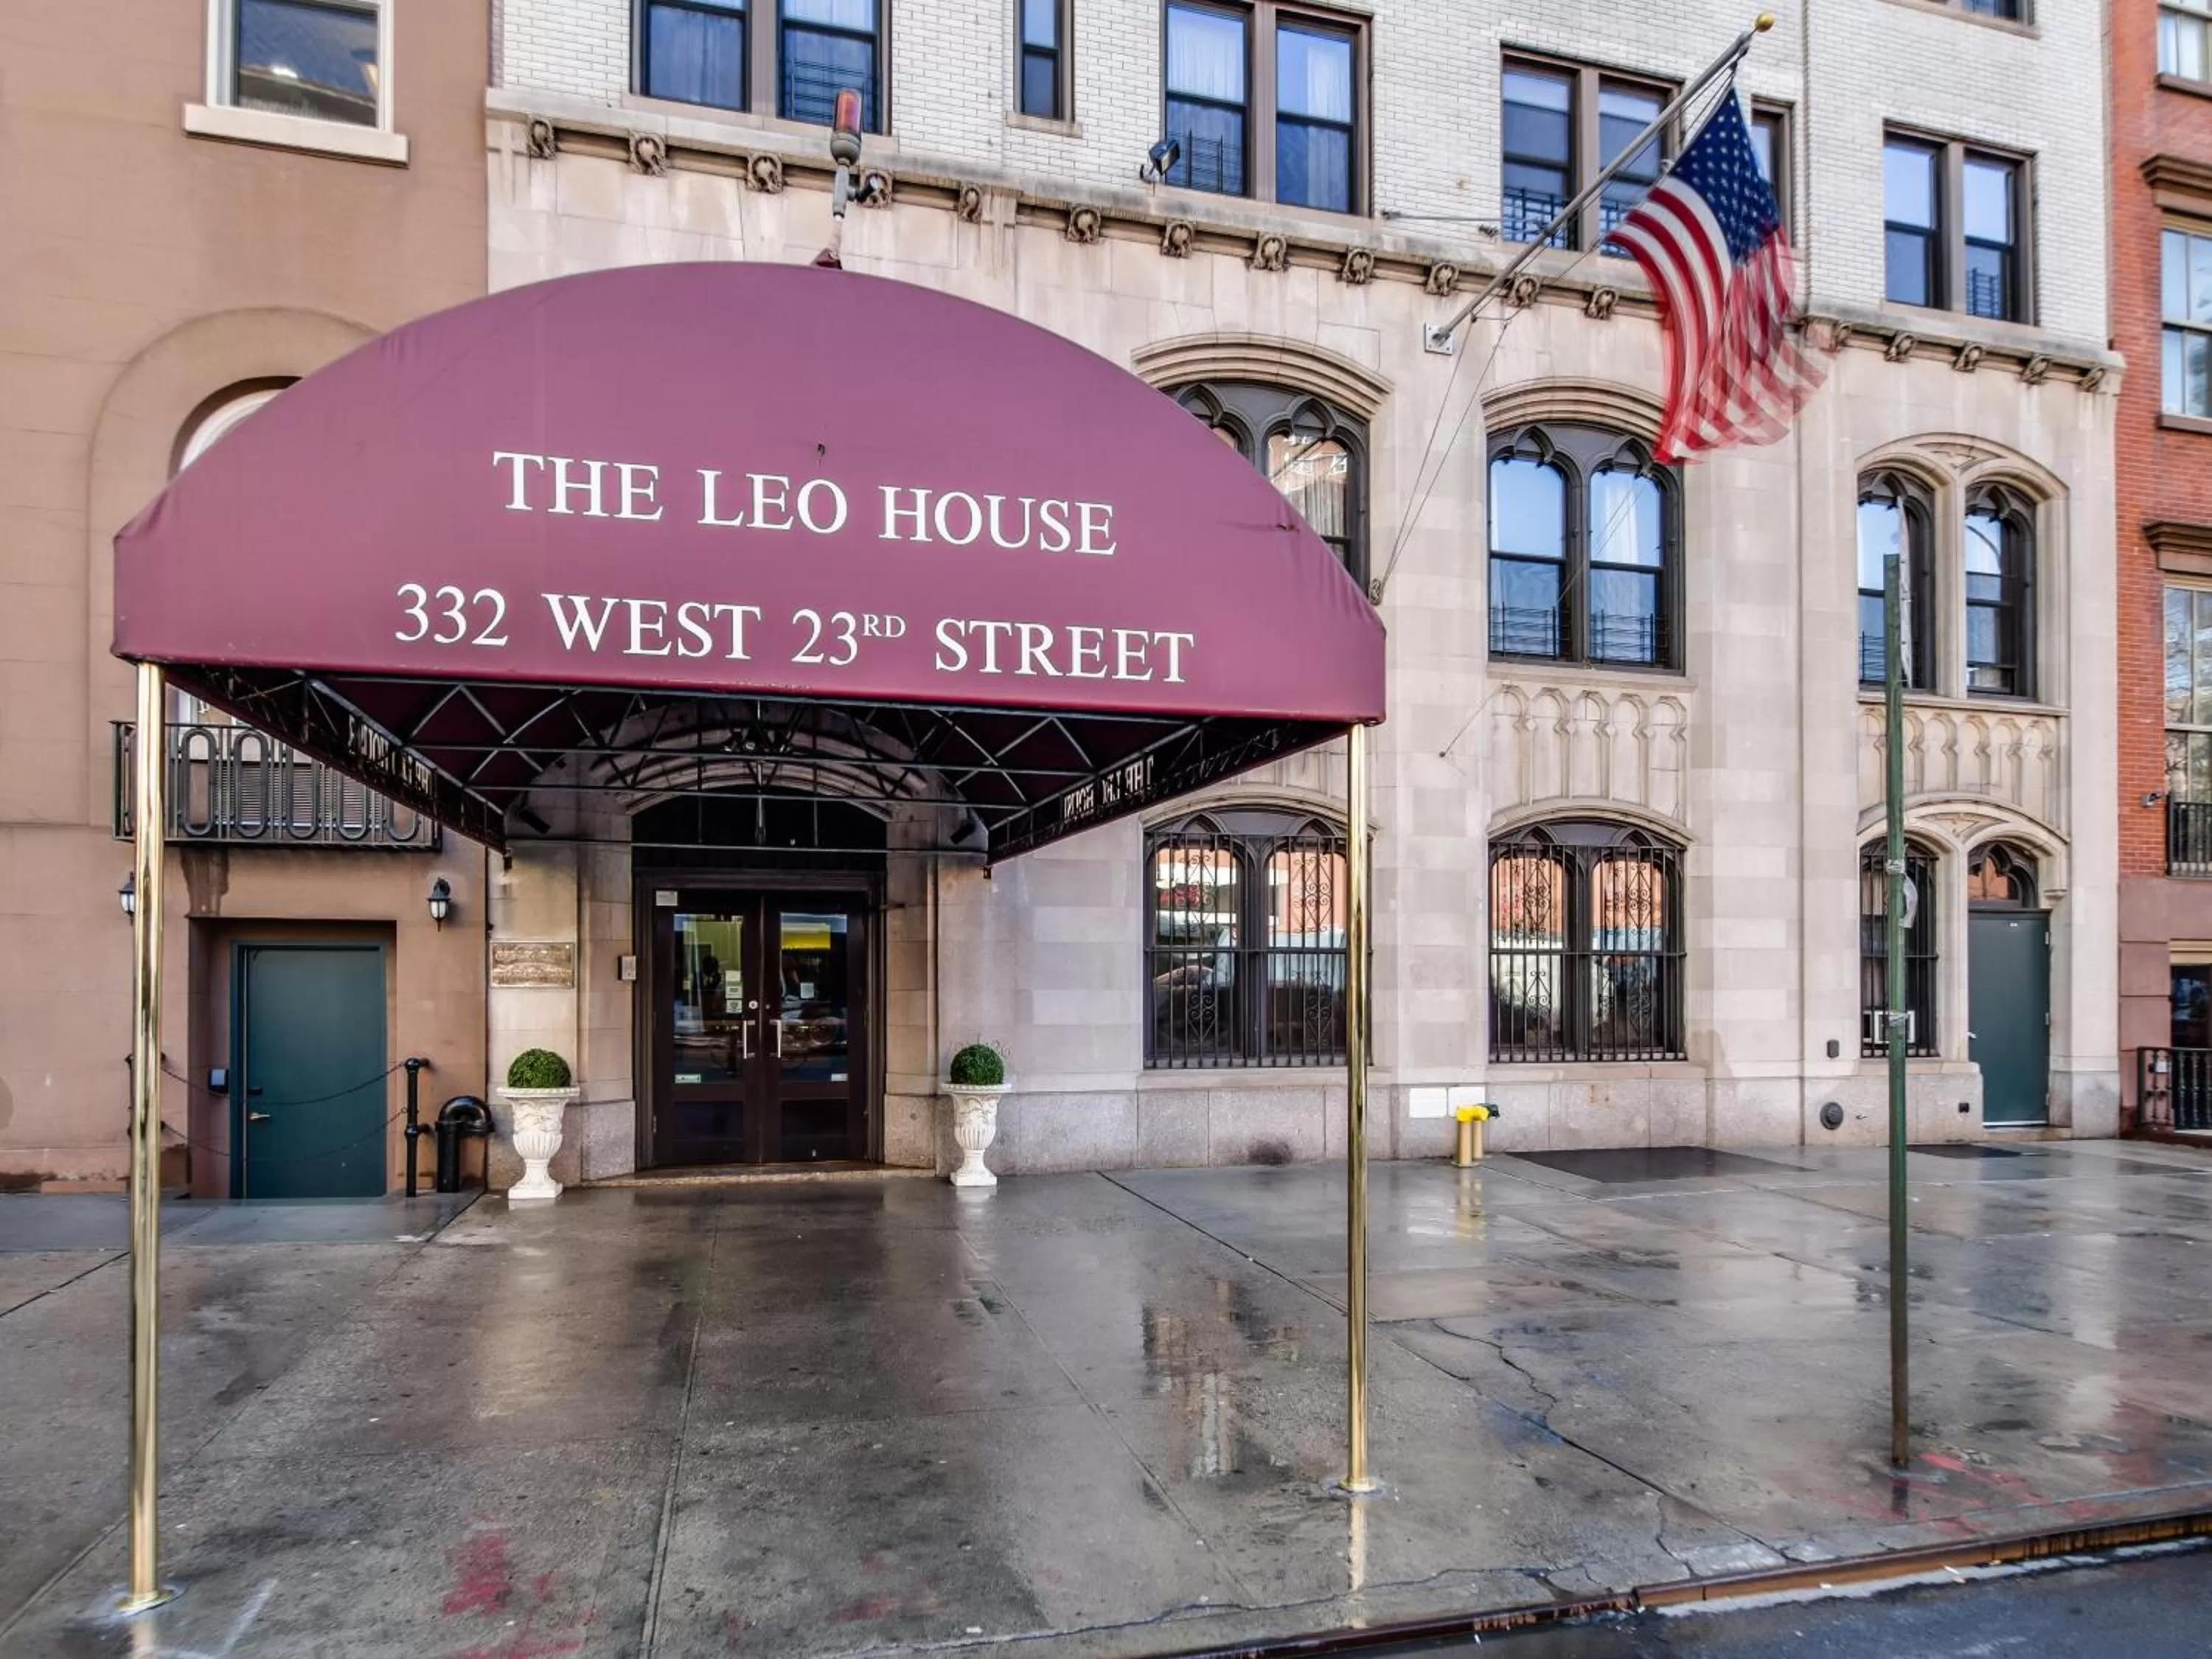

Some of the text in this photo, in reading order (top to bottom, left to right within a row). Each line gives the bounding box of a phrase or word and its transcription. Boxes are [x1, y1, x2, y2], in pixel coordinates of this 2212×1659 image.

[493, 451, 1118, 555] THE LEO HOUSE
[395, 583, 1194, 683] 332 WEST 23RD STREET
